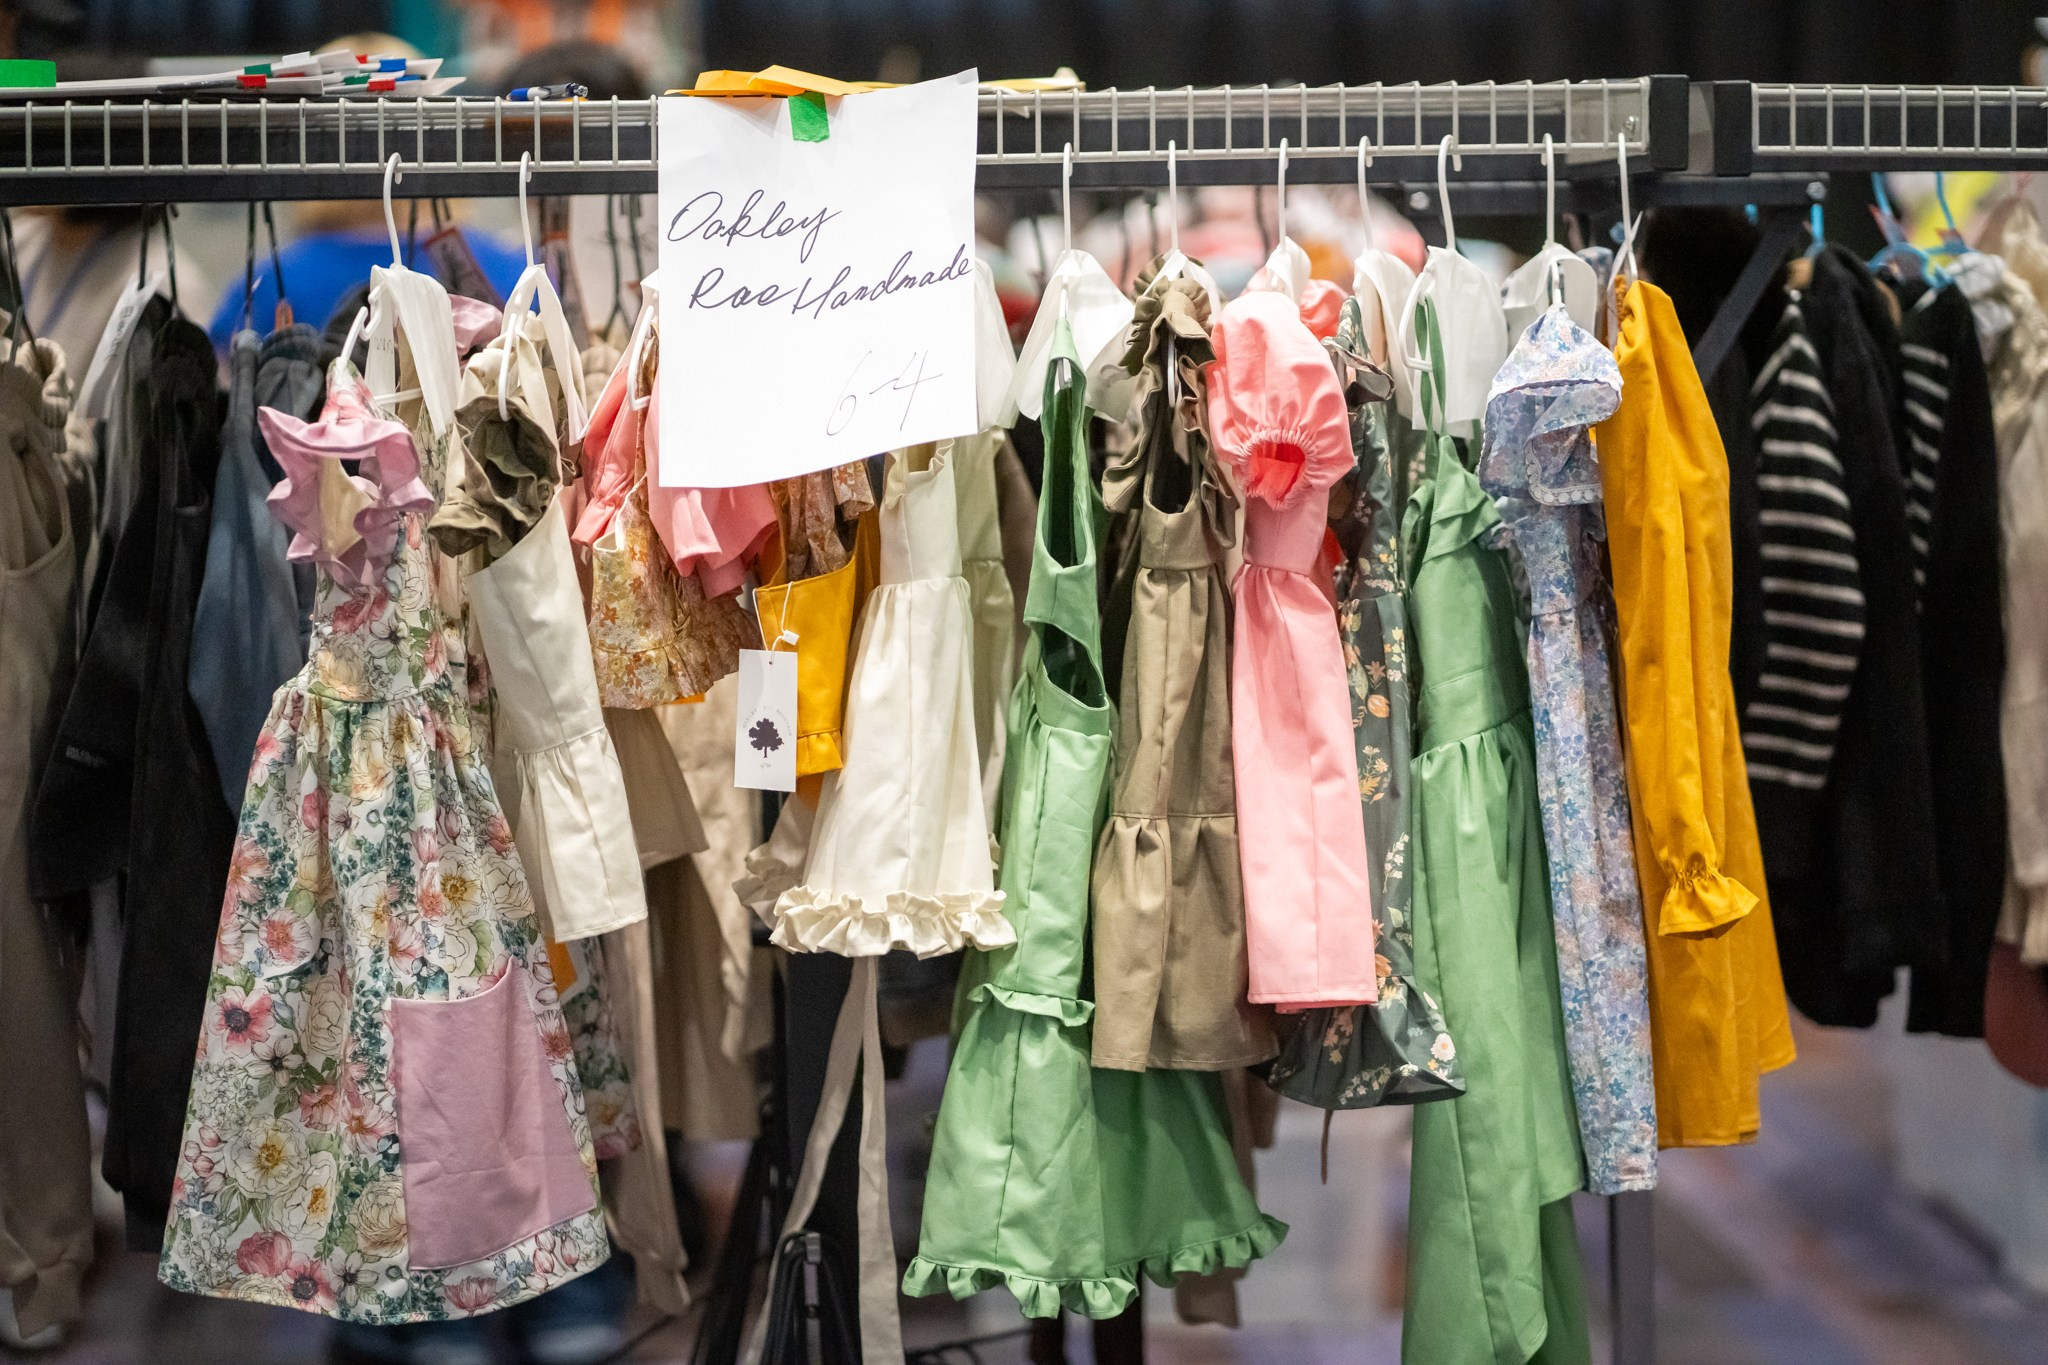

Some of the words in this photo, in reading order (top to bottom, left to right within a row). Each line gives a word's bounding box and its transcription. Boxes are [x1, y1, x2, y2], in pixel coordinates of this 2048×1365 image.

[667, 189, 842, 264] Oakley
[688, 267, 798, 309] Rae
[791, 243, 973, 319] Handmade
